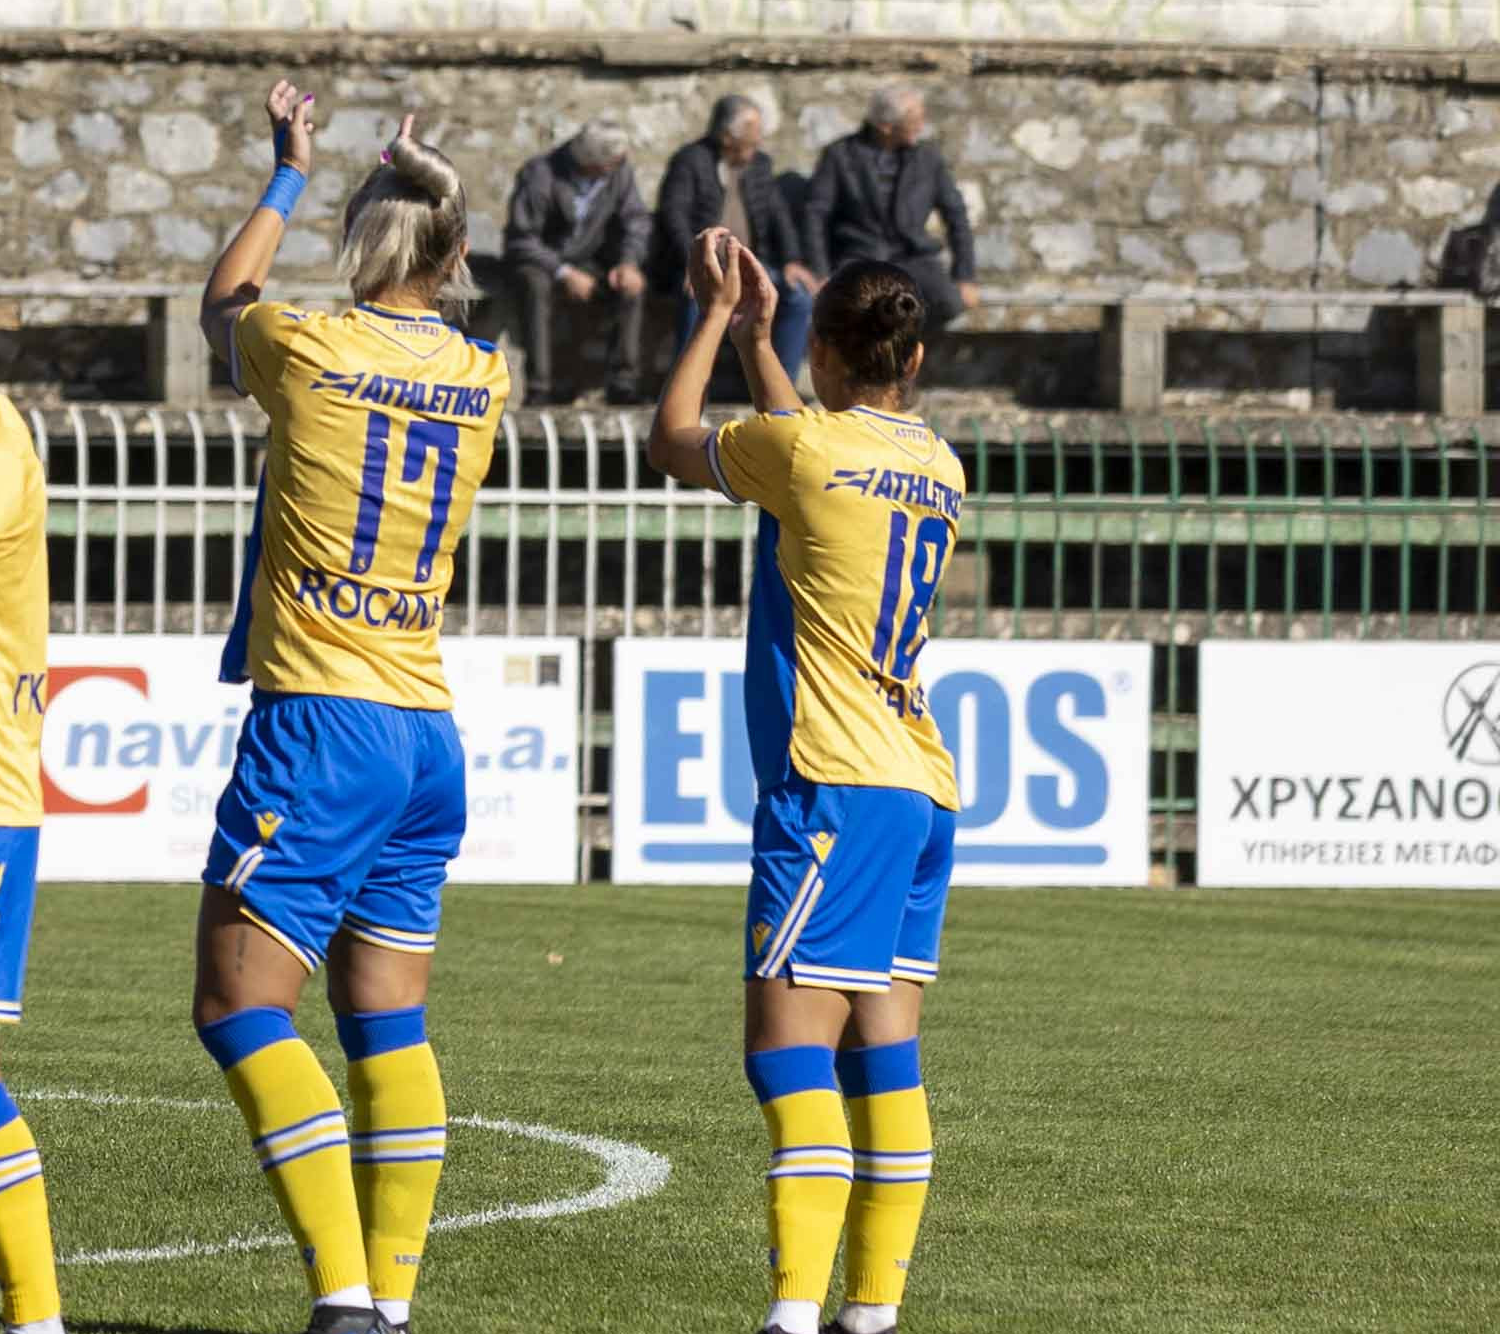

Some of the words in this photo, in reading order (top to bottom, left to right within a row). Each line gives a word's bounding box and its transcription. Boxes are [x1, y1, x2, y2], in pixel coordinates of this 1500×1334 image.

[359, 372, 490, 418] ATHLETIKO
[350, 411, 460, 583] 17
[1228, 776, 1500, 822] ΧΡΥΣΑΝΘ
